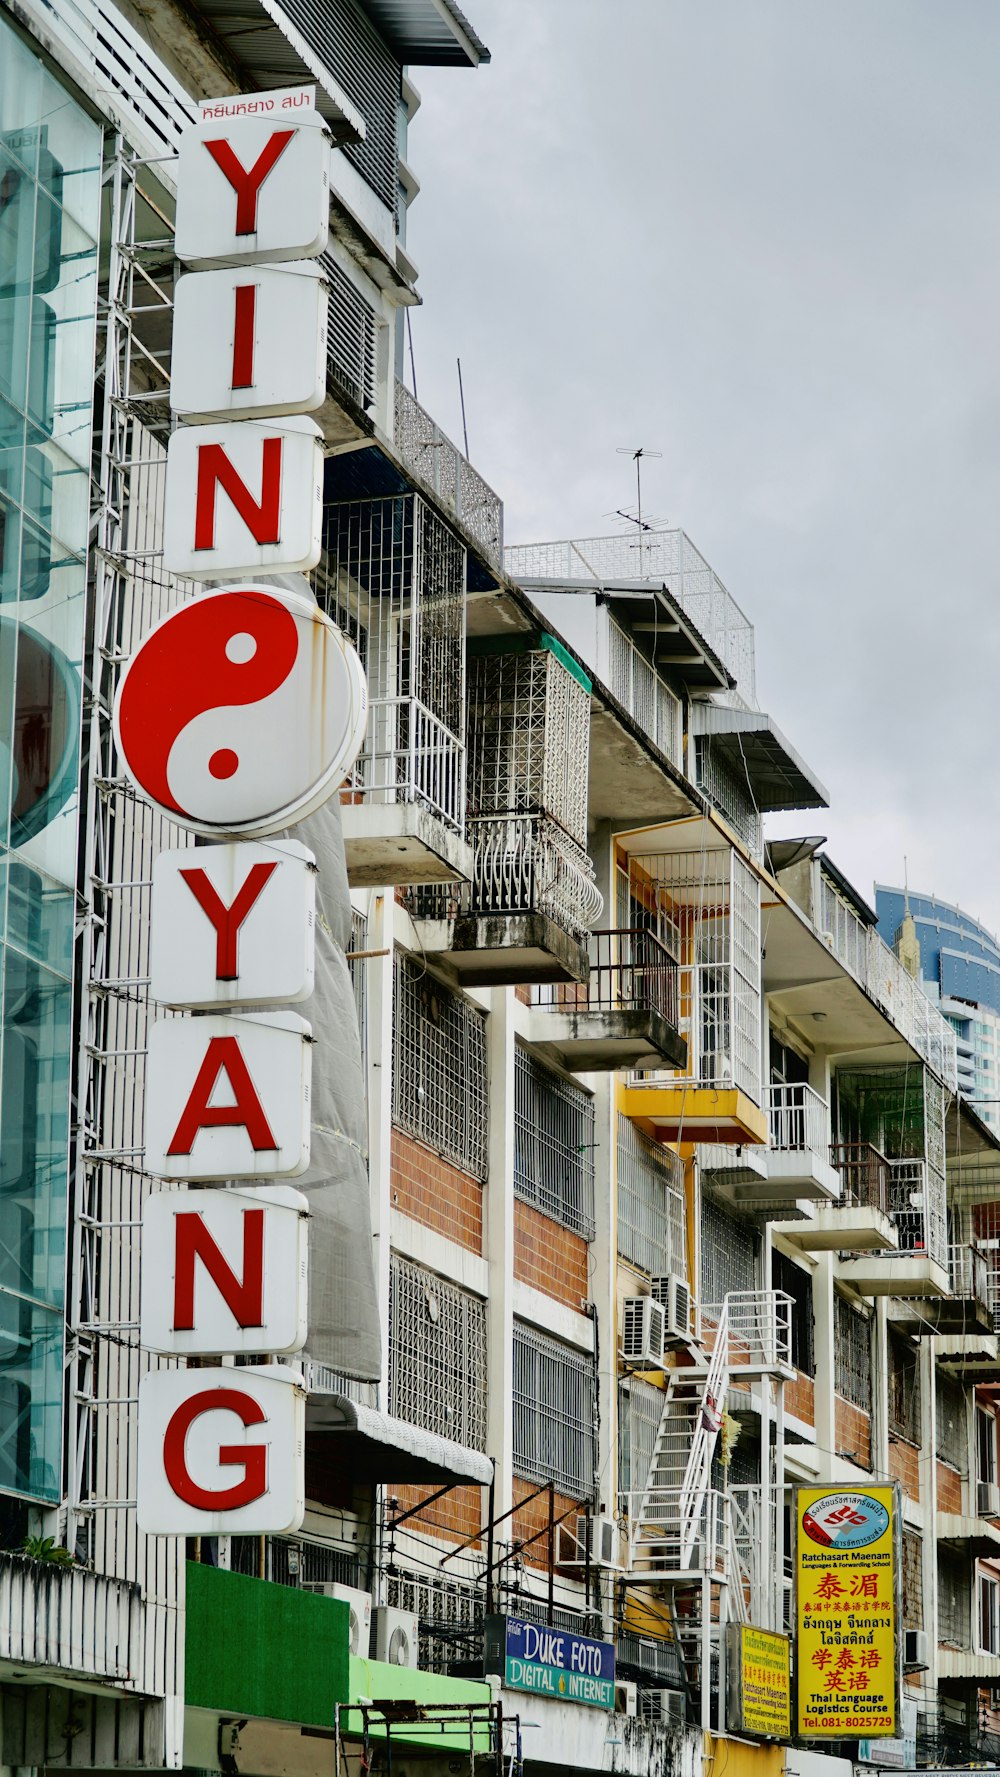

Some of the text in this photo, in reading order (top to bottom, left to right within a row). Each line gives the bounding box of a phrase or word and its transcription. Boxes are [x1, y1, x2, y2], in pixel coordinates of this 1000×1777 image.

[282, 93, 310, 109] สปา
[163, 130, 294, 1509] YIN YANG
[802, 1552, 890, 1561] Ratchasart Maenam
[813, 1572, 879, 1600] 泰湄
[803, 1614, 891, 1632] อังกฤษ จีนกลาง
[820, 1630, 874, 1645] โลจิสติกส์
[523, 1623, 602, 1676] DUKE FOTO
[811, 1648, 882, 1670] 学泰语
[510, 1659, 612, 1703] DIGITAL INTERNET
[824, 1670, 871, 1692] 英语
[806, 1704, 888, 1714] Logistics Course
[810, 1694, 884, 1704] Thai Language
